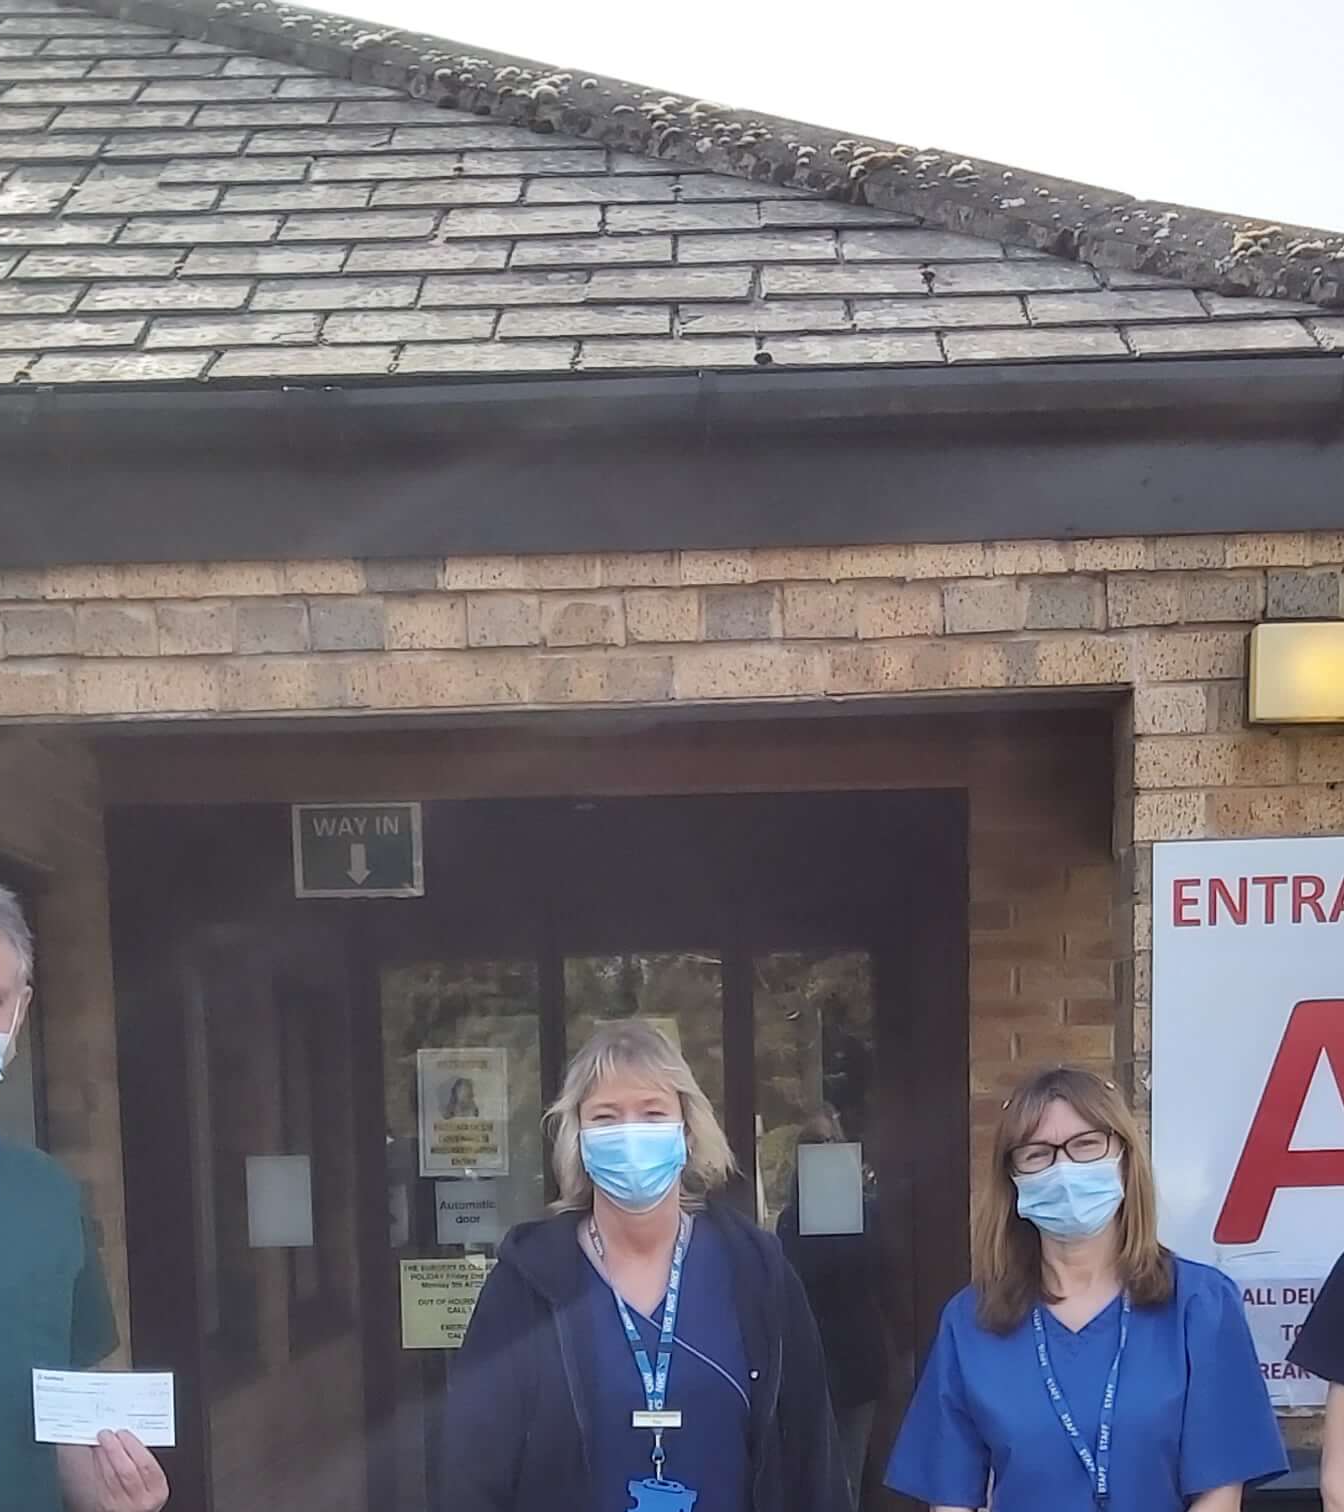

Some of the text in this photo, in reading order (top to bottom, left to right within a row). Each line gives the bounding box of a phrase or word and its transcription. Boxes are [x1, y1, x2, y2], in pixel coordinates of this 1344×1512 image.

[312, 815, 400, 837] WAY IN
[439, 1201, 497, 1210] Automatic
[455, 1215, 481, 1224] door
[1242, 1287, 1316, 1306] ALL DEL
[1099, 1423, 1111, 1451] STAFF
